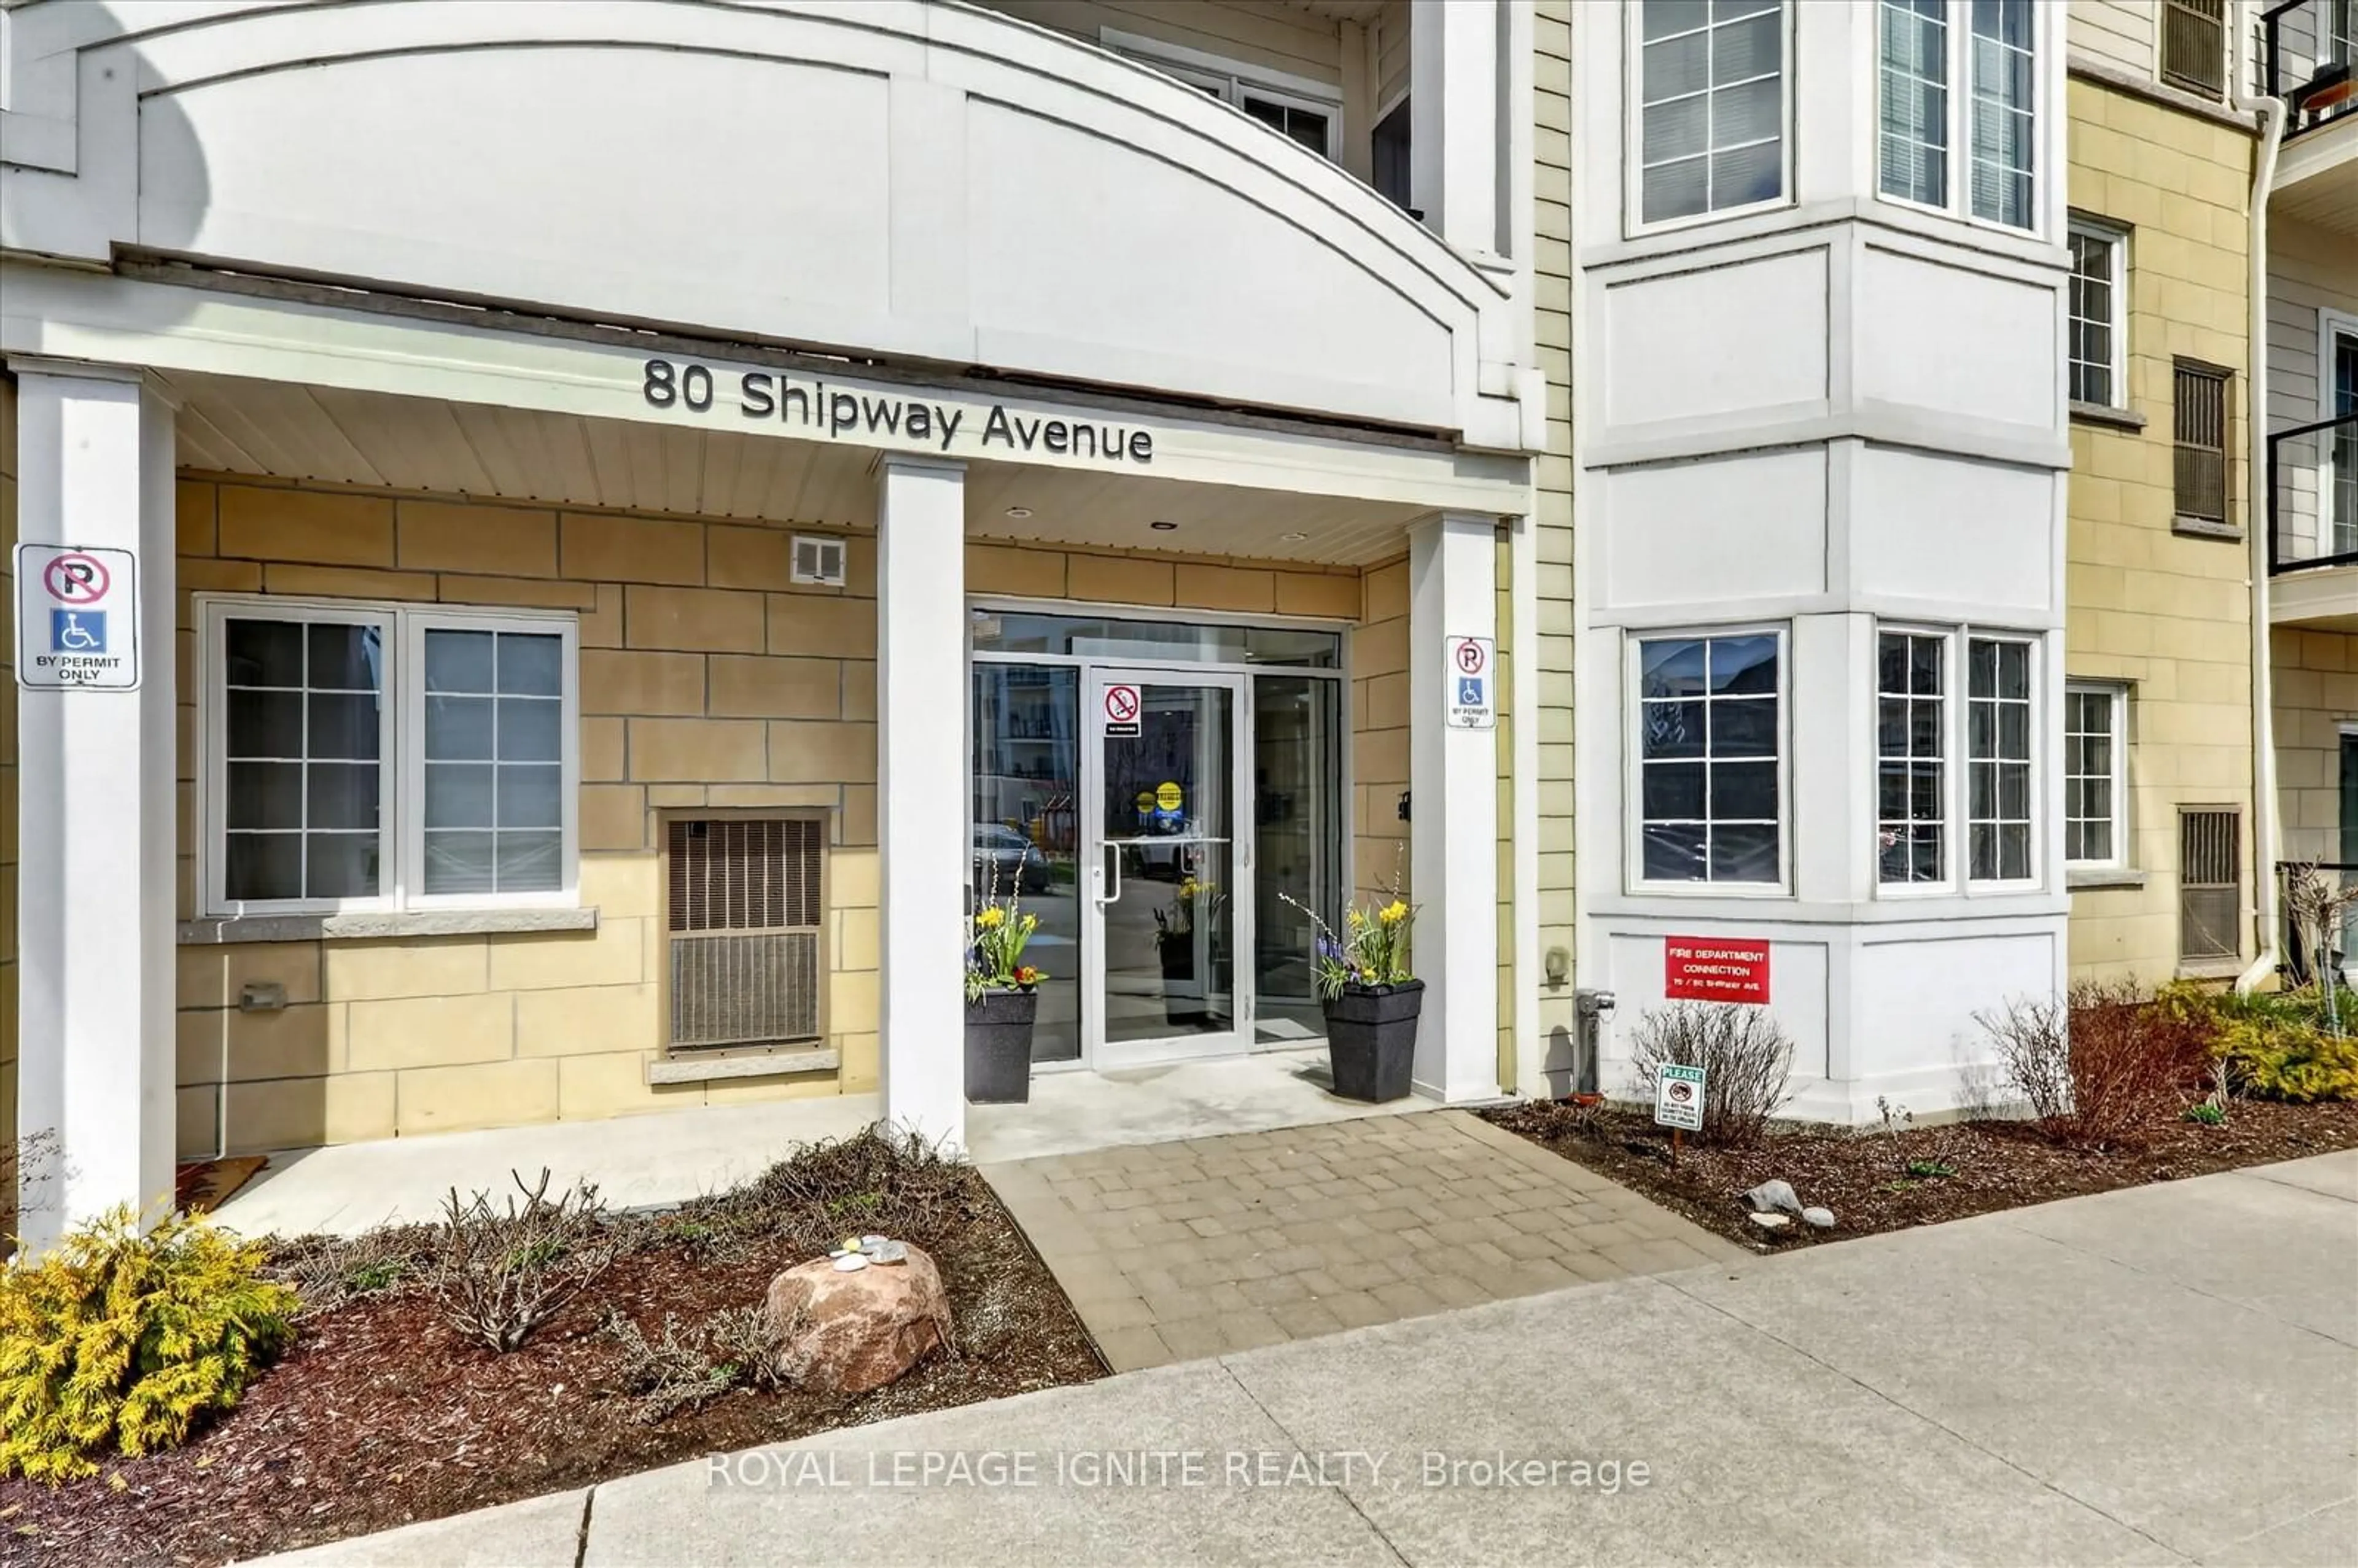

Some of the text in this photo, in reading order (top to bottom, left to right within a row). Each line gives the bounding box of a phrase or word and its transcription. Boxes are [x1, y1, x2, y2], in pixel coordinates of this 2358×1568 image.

[645, 359, 1152, 464] 80 Shipway Avenue
[36, 656, 120, 668] BY PERMIT
[59, 670, 100, 680] ONLY
[1670, 948, 1764, 961] FIRE DEPARTMENT
[1684, 965, 1749, 976] CONNECTION
[1664, 1068, 1700, 1081] PLEASE
